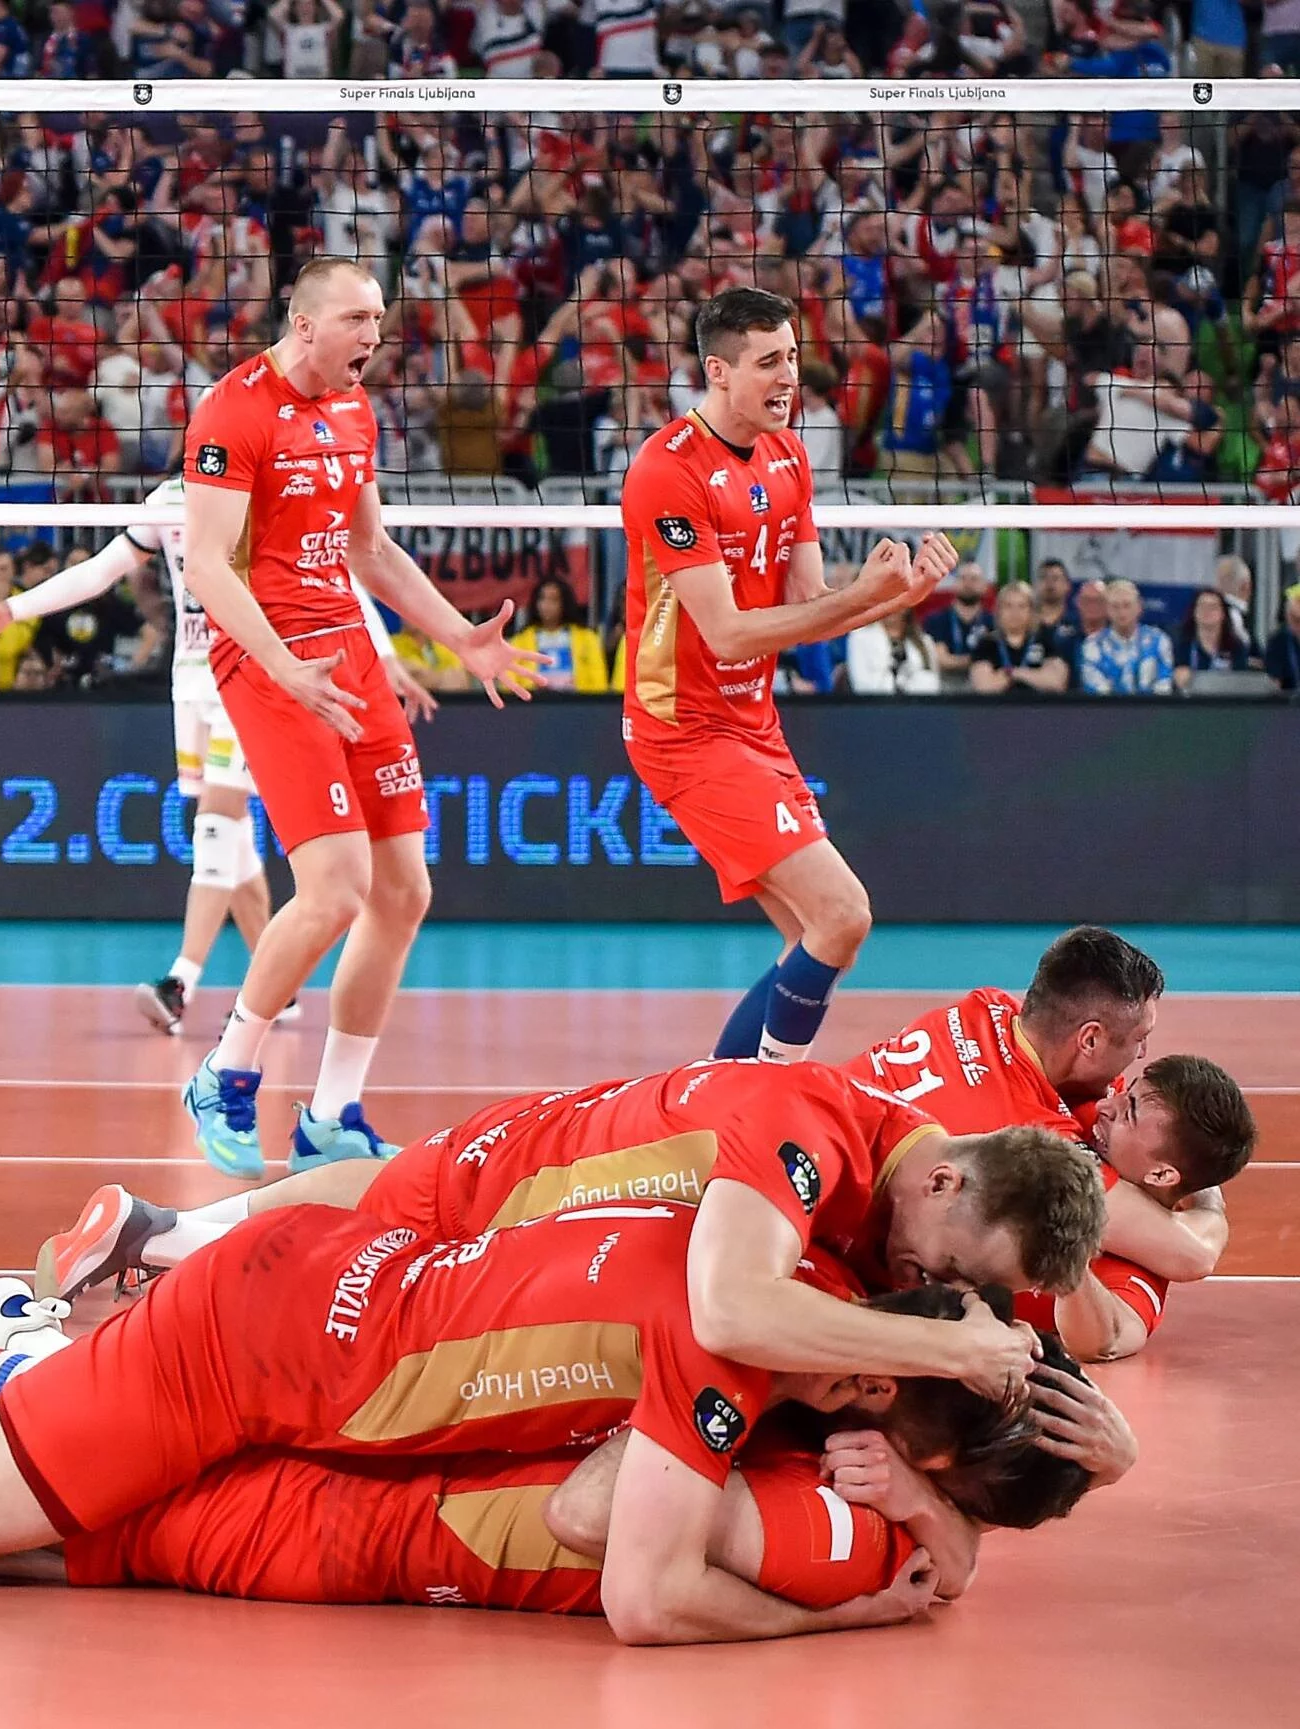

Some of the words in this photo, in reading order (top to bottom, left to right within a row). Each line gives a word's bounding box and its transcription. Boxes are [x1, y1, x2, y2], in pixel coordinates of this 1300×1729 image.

[341, 88, 375, 100] Super
[380, 88, 414, 98] Finals
[419, 88, 475, 100] Ljubljana
[870, 88, 905, 100] Super
[910, 87, 944, 97] Finals
[949, 87, 1005, 100] Ljubljana
[749, 523, 769, 576] 4
[329, 782, 351, 817] 9
[774, 801, 801, 833] 4
[946, 1006, 970, 1064] PRODUCTS
[964, 1039, 982, 1060] AIR
[886, 1029, 946, 1102] 21
[796, 1152, 818, 1182] CEV
[627, 1168, 701, 1200] Hotel
[460, 1369, 524, 1402] Hugo
[534, 1361, 614, 1391] Hotel
[713, 1398, 739, 1424] CEV
